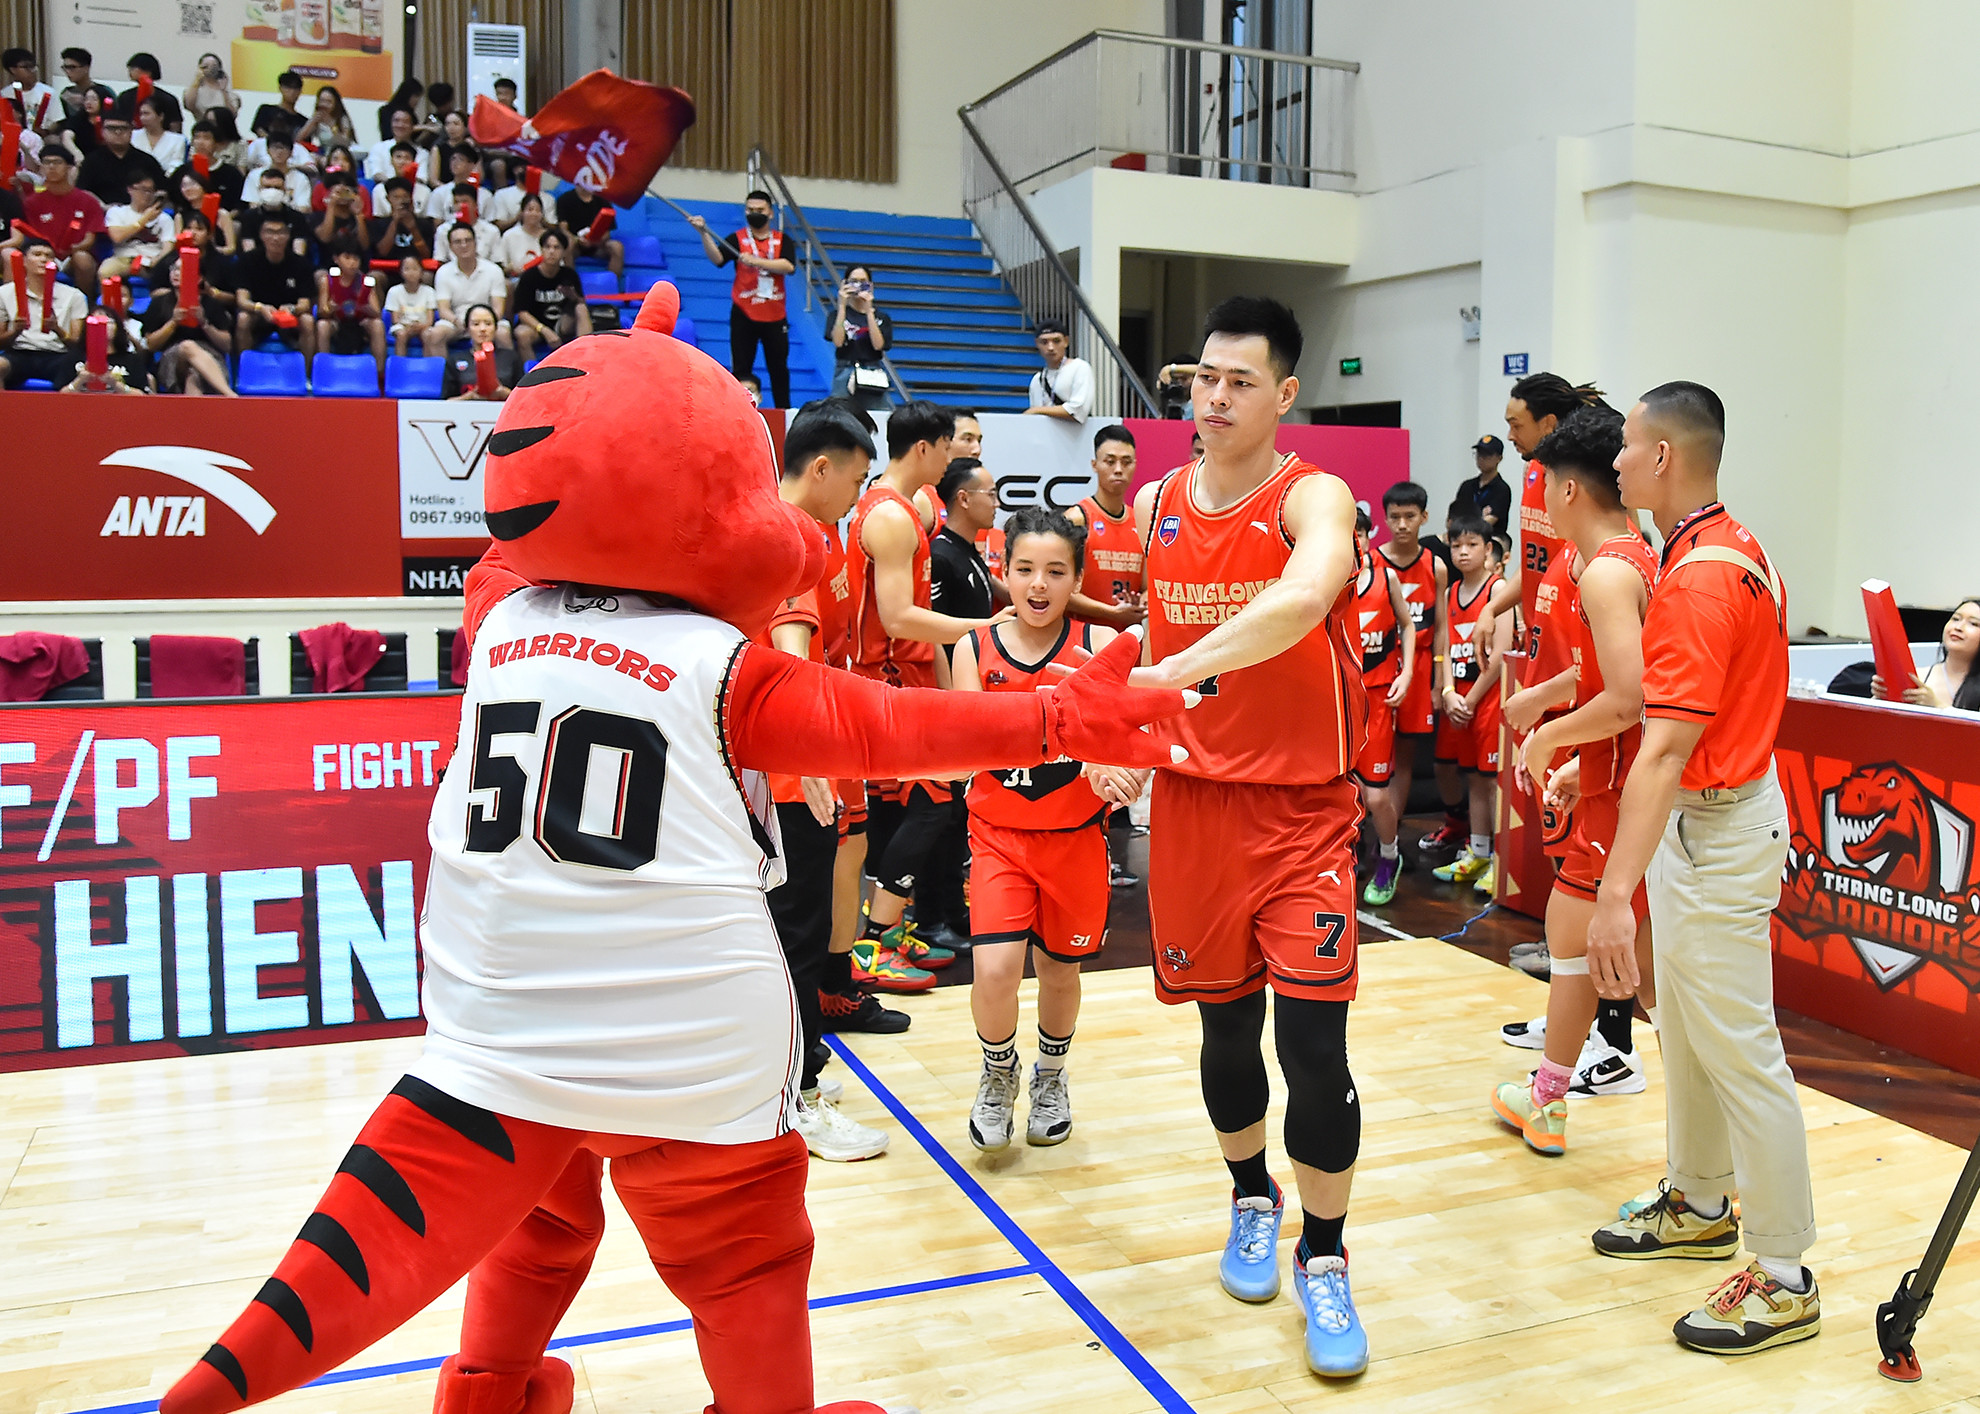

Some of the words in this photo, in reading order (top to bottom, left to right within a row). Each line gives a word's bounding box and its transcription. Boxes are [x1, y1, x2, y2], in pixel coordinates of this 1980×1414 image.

[1507, 355, 1525, 368] WC
[100, 496, 206, 536] ANTA
[409, 494, 456, 506] Hotline
[409, 565, 465, 590] NHÃ
[1526, 543, 1548, 575] 22
[489, 632, 677, 692] WARRIORS
[312, 740, 440, 791] FIGHT
[463, 699, 671, 874] 50
[1823, 871, 1895, 907] THANG
[1897, 890, 1958, 924] LONG
[54, 860, 420, 1048] HIEN
[1070, 934, 1091, 947] 31
[1314, 912, 1347, 959] 7
